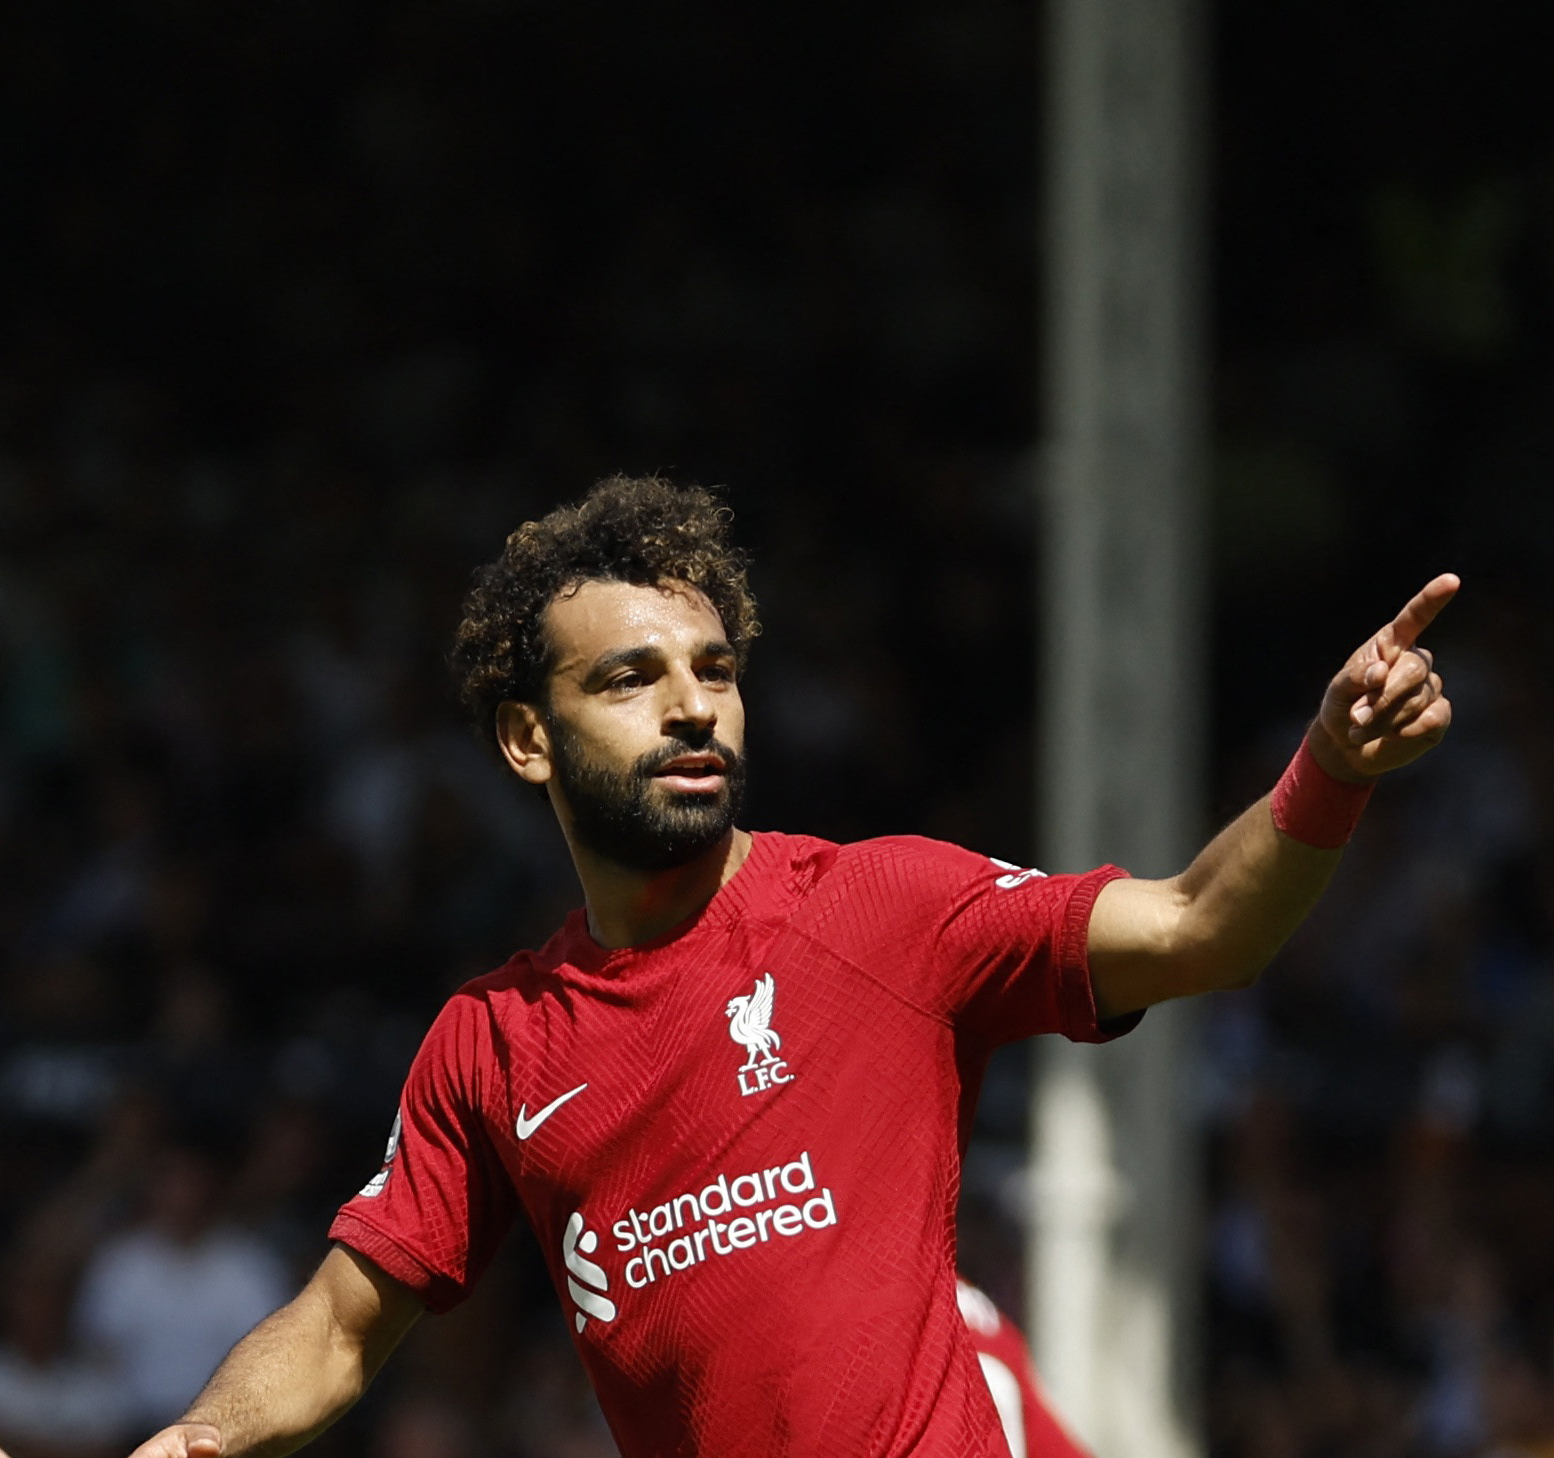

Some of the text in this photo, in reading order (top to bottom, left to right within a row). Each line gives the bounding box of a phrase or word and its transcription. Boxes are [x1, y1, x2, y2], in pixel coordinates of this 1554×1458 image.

[737, 1061, 796, 1097] L.F.C.
[612, 1150, 815, 1252] standard
[625, 1187, 838, 1289] chartered
